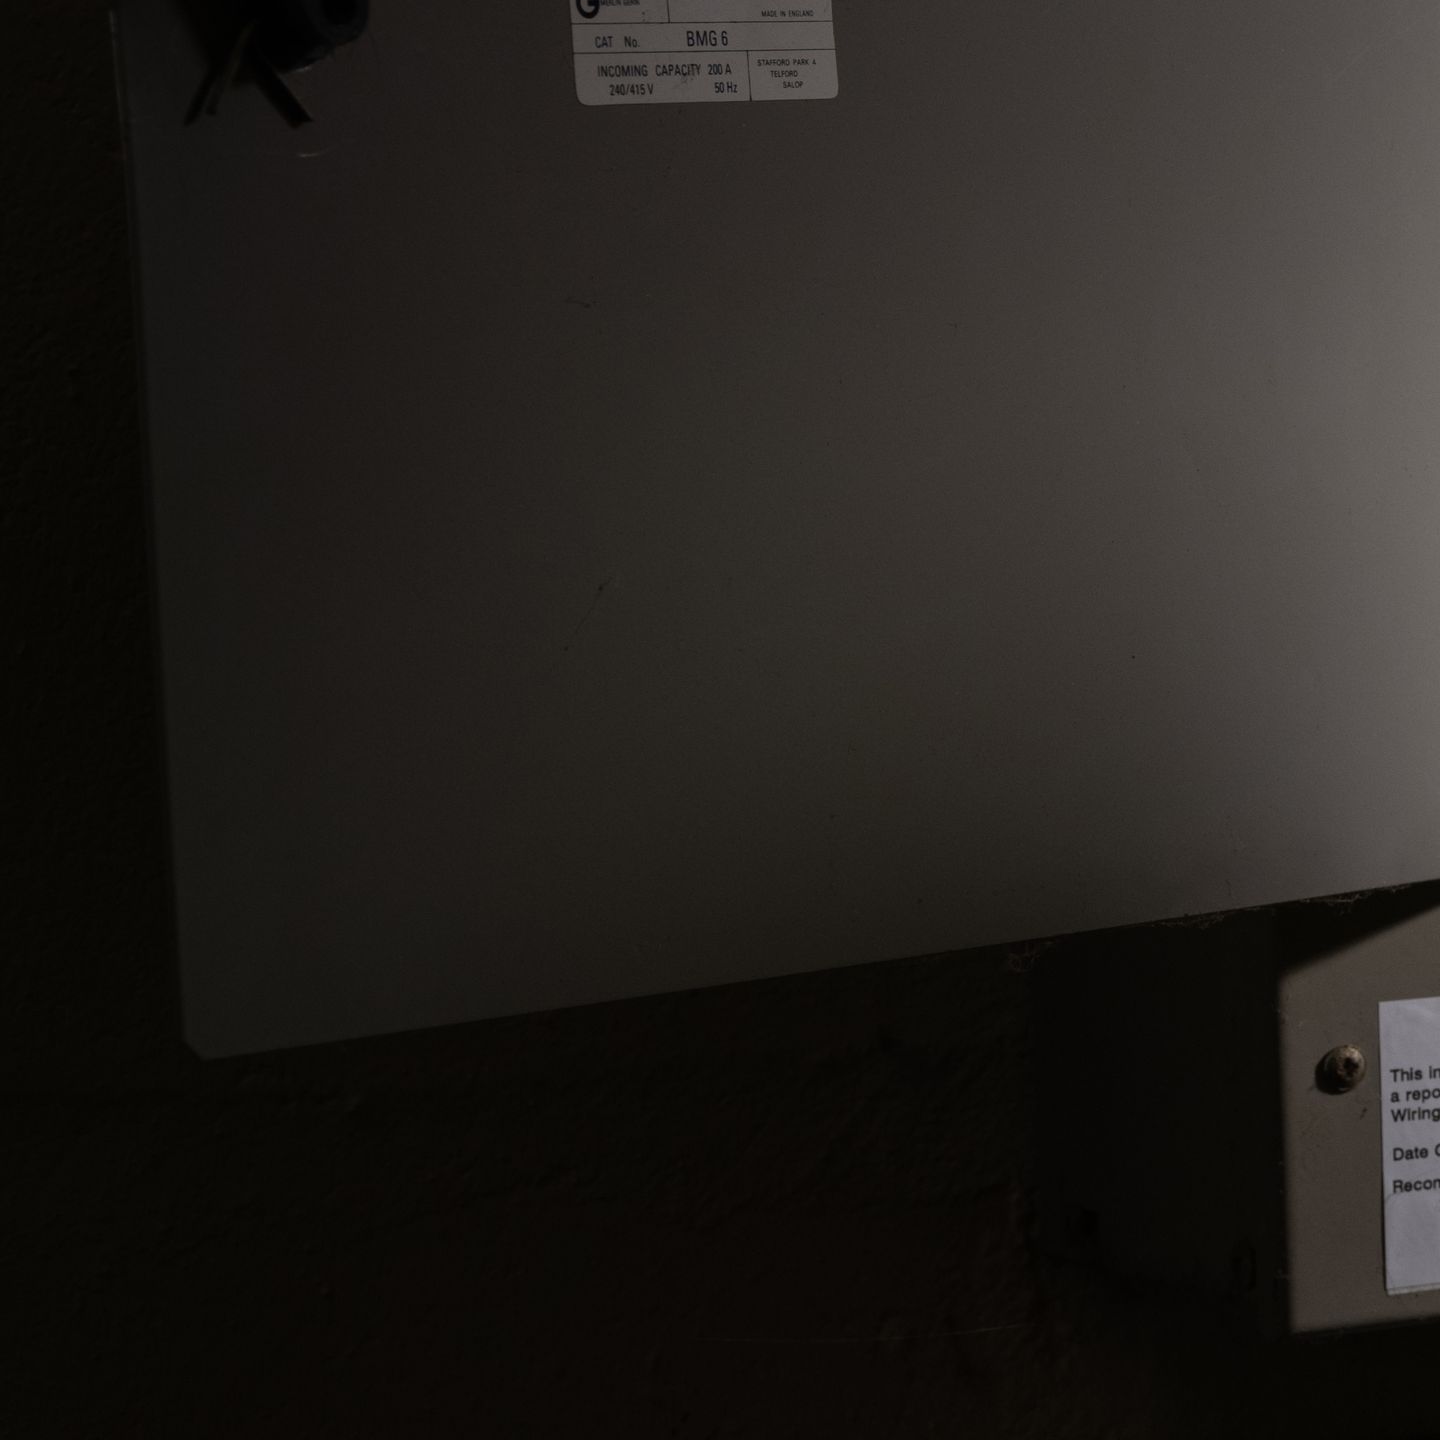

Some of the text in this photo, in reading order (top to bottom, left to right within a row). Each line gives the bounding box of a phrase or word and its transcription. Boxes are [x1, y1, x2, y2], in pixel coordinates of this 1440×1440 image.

[759, 8, 814, 18] MADE IN ENGLAND
[593, 34, 613, 49] CAT
[685, 28, 718, 47] BMG
[756, 57, 791, 67] STAFFORD
[791, 57, 809, 66] PARK
[596, 63, 649, 78] INCOMING
[654, 62, 701, 78] CAPACITY
[706, 62, 724, 76] 200
[769, 68, 799, 78] TELFORD
[608, 82, 646, 97] 240/415
[713, 80, 738, 94] 50 Hz
[781, 79, 804, 89] SALOP
[1388, 1066, 1423, 1083] This
[1389, 1090, 1400, 1103] a
[1390, 1106, 1440, 1123] Wiring
[1391, 1145, 1429, 1162] Date
